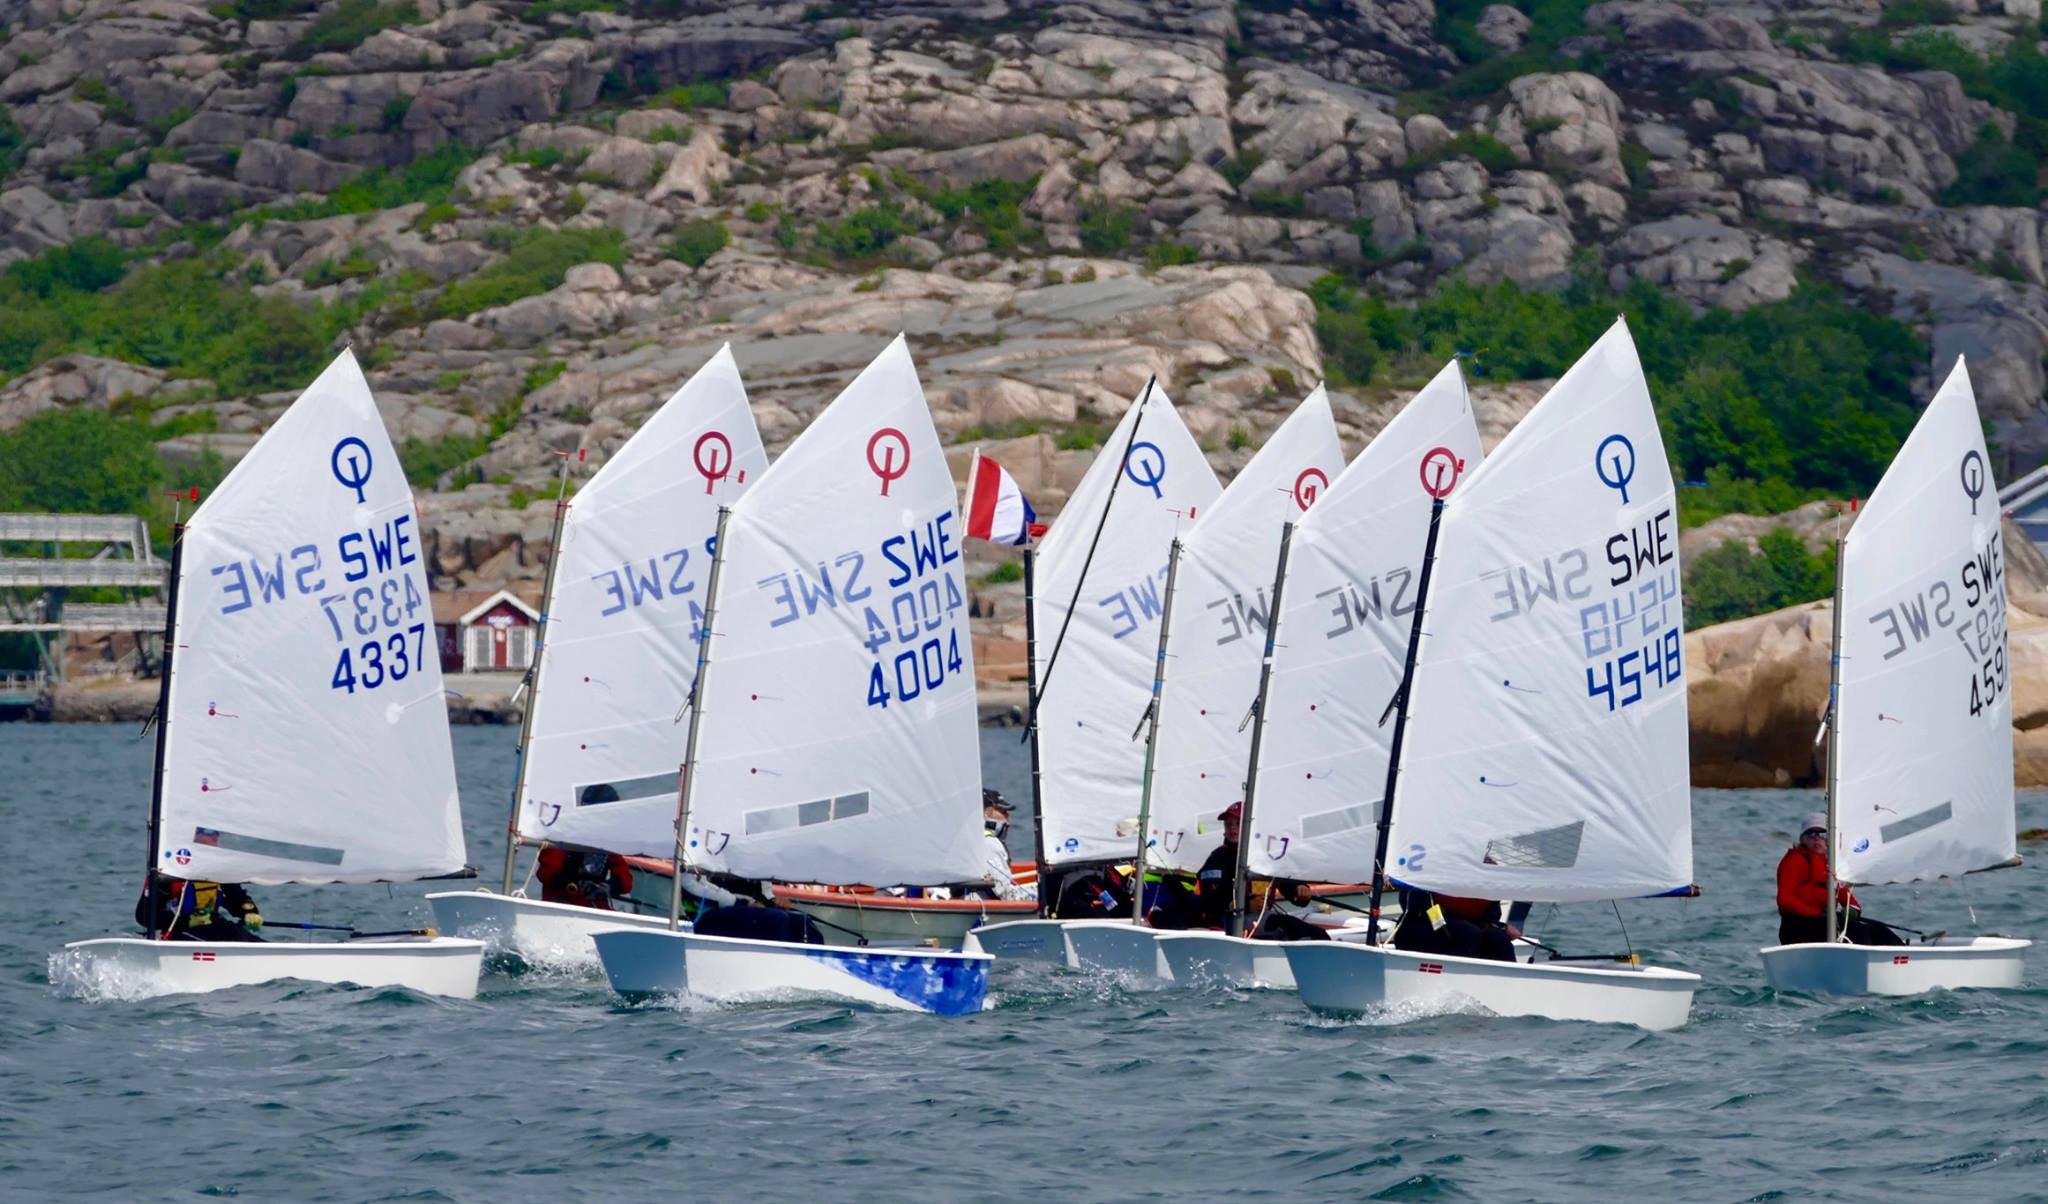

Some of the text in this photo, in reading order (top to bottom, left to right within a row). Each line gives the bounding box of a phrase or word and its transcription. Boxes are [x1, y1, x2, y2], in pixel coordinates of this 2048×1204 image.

[338, 514, 416, 582] SWE
[881, 510, 959, 588] SWE
[1606, 509, 1674, 587] SWE
[1961, 530, 2003, 608] SWE
[331, 623, 425, 694] 4337
[867, 627, 963, 709] 4004
[1586, 627, 1682, 712] 4548
